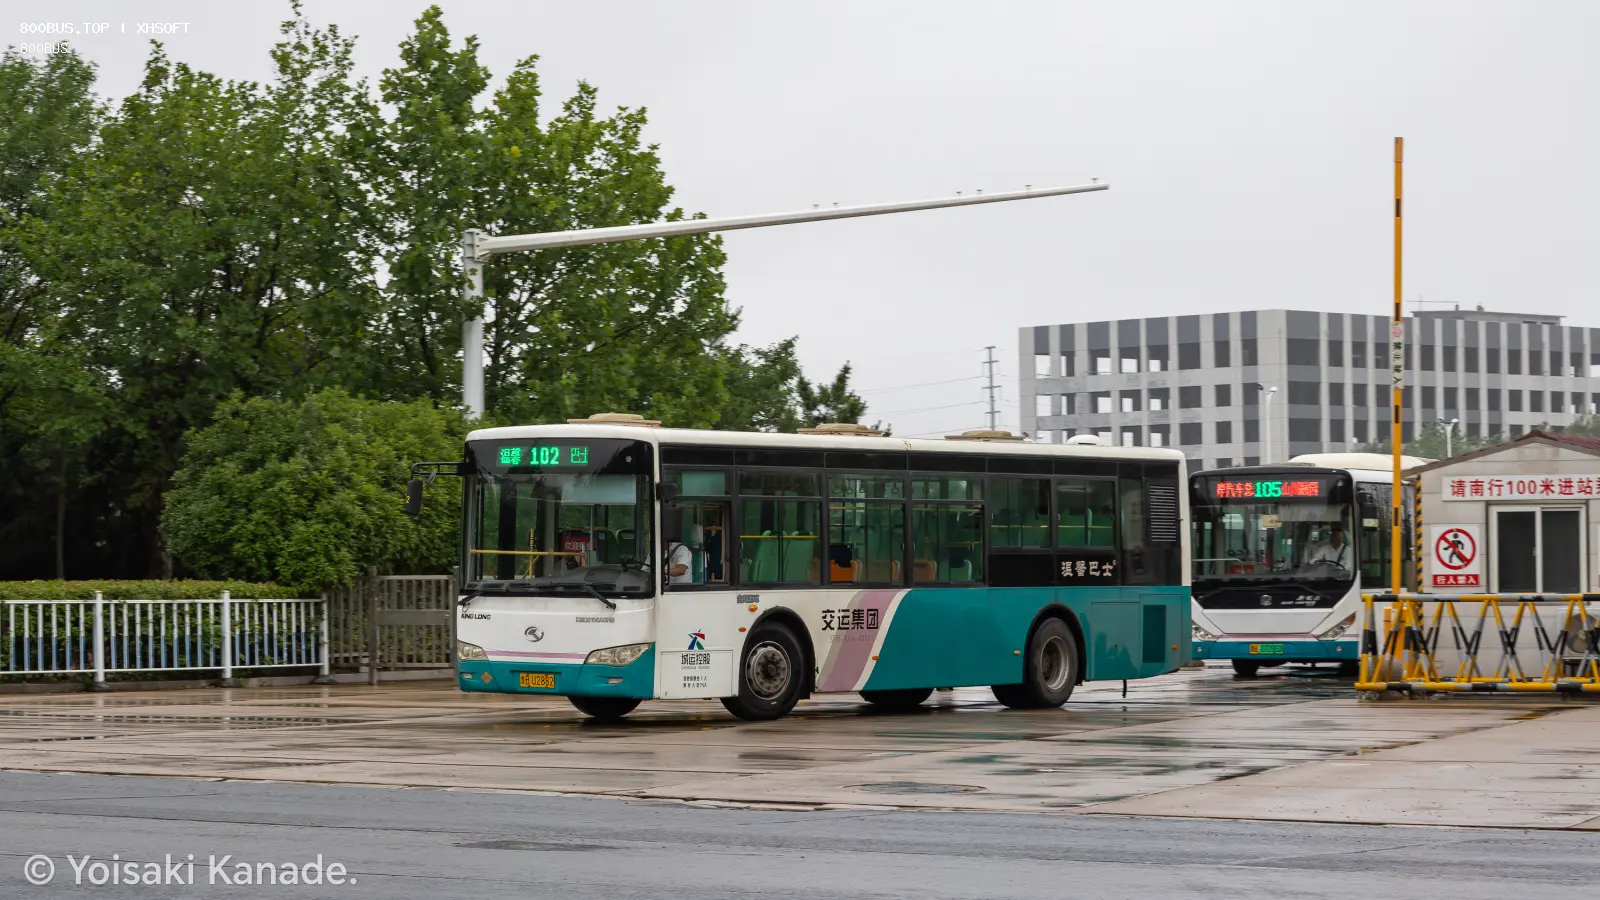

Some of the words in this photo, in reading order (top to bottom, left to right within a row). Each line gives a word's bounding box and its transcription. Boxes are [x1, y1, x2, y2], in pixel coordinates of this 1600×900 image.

[530, 447, 560, 465] 102
[1254, 481, 1284, 497] 105
[1450, 477, 1600, 497] 请南行100米进站
[821, 608, 879, 631] 交运集团
[680, 652, 711, 666] 城运控股
